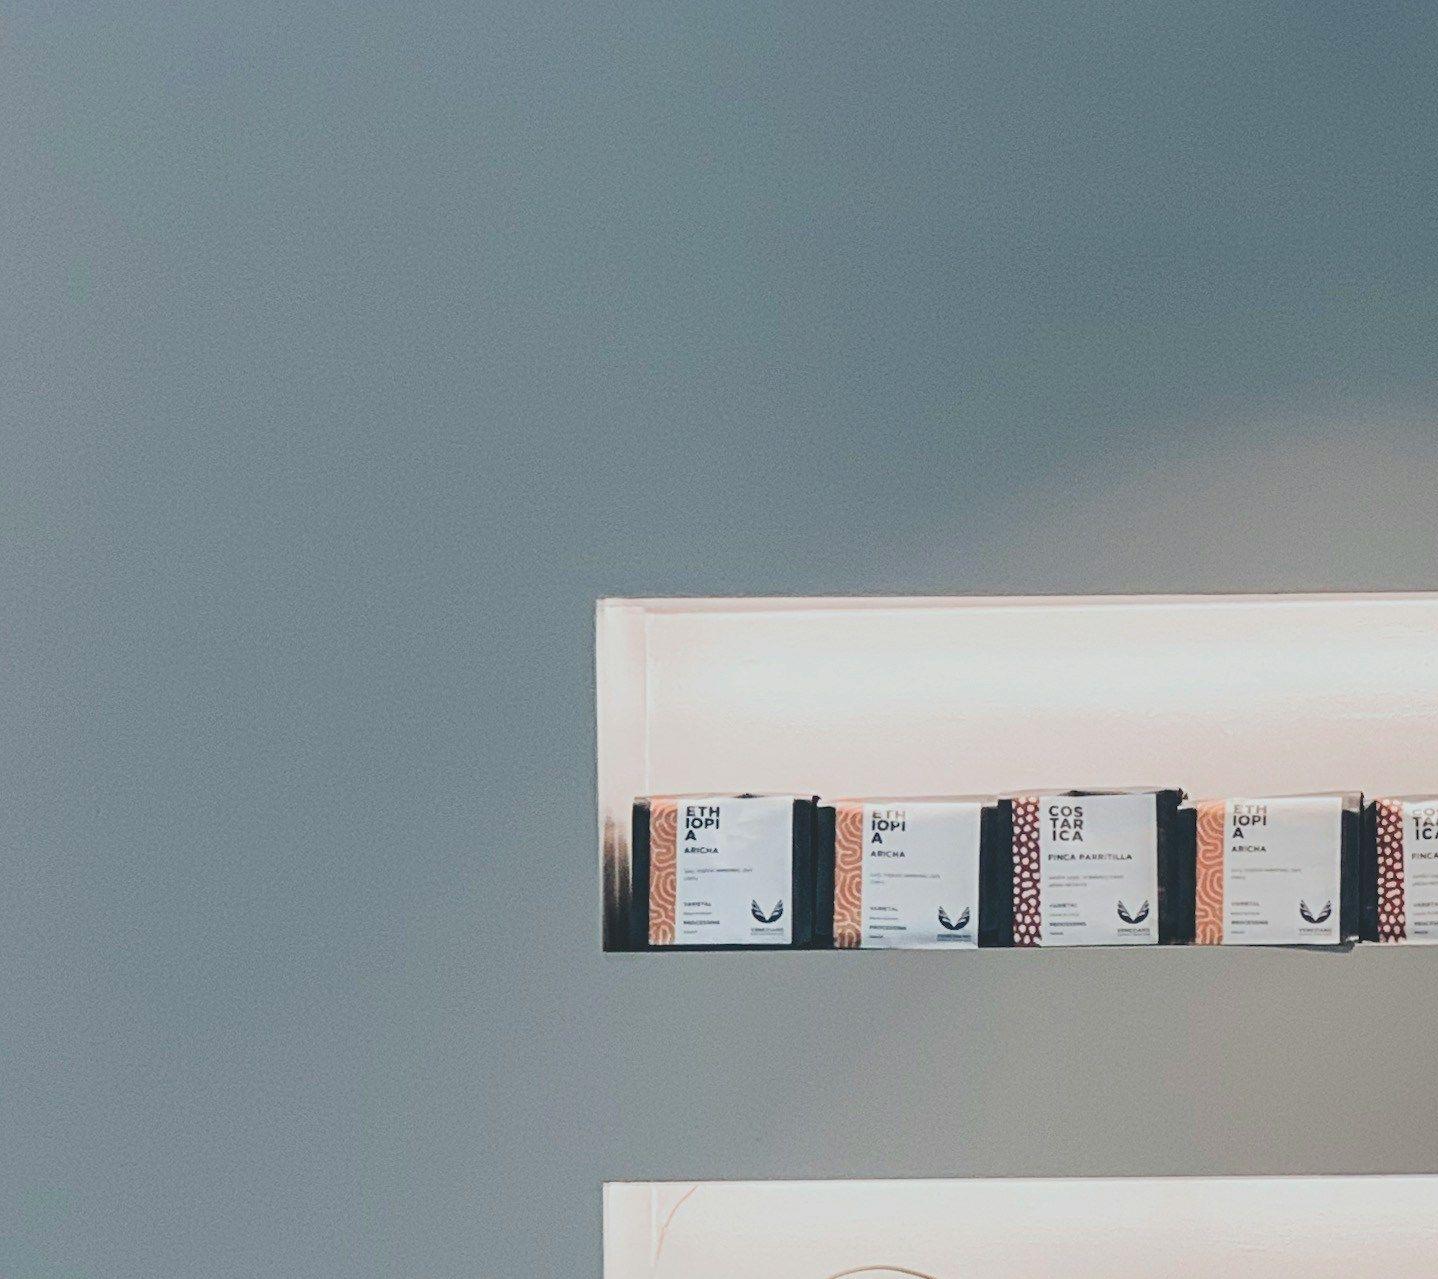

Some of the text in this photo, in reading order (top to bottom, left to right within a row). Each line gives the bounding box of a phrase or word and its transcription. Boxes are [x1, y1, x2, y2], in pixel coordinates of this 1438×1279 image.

[686, 806, 720, 817] ETH
[872, 810, 905, 819] ETH
[1049, 806, 1083, 817] COS
[1233, 804, 1267, 814] ETH
[685, 818, 720, 829] IOPI
[872, 820, 905, 832] IOPI
[1050, 818, 1083, 830] TAR
[1233, 815, 1267, 826] IOPI
[685, 830, 697, 841] A
[871, 832, 883, 844] A
[1052, 831, 1083, 842] ICA
[1233, 827, 1244, 839] A
[1411, 852, 1438, 861] FINCA
